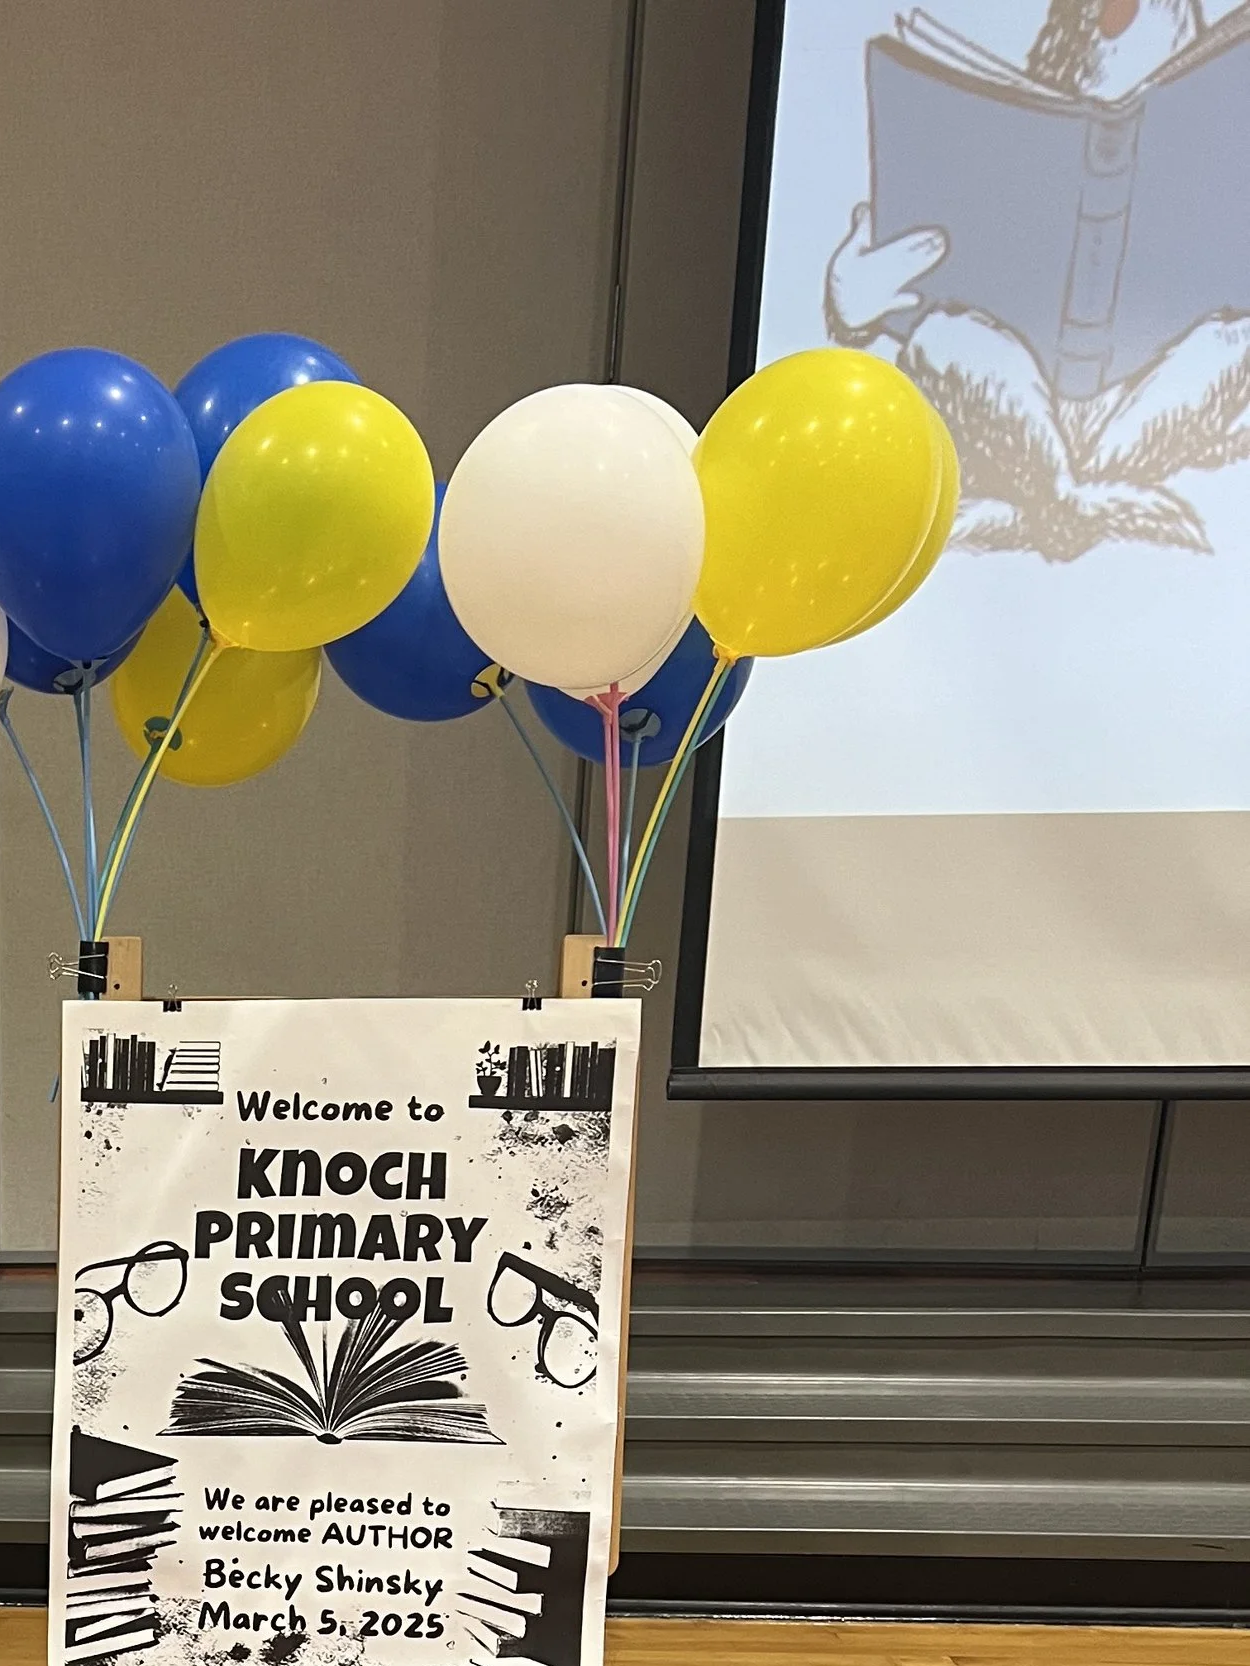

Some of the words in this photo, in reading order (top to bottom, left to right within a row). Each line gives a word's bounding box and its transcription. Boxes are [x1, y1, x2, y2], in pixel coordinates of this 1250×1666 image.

[237, 1090, 393, 1121] Welcome
[407, 1095, 445, 1121] to
[237, 1147, 447, 1200] KNOCH
[194, 1210, 489, 1262] PRIMARY
[219, 1271, 454, 1323] SCHOOL
[204, 1487, 245, 1511] We
[255, 1495, 300, 1512] are
[309, 1491, 412, 1521] pleased
[422, 1497, 451, 1517] to
[199, 1521, 311, 1543] welcome
[321, 1522, 453, 1549] AUTHOR
[204, 1558, 302, 1600] Becky
[315, 1564, 443, 1606] Shinsky
[198, 1601, 307, 1632] March
[317, 1608, 347, 1636] 5,
[360, 1611, 445, 1639] 2025
